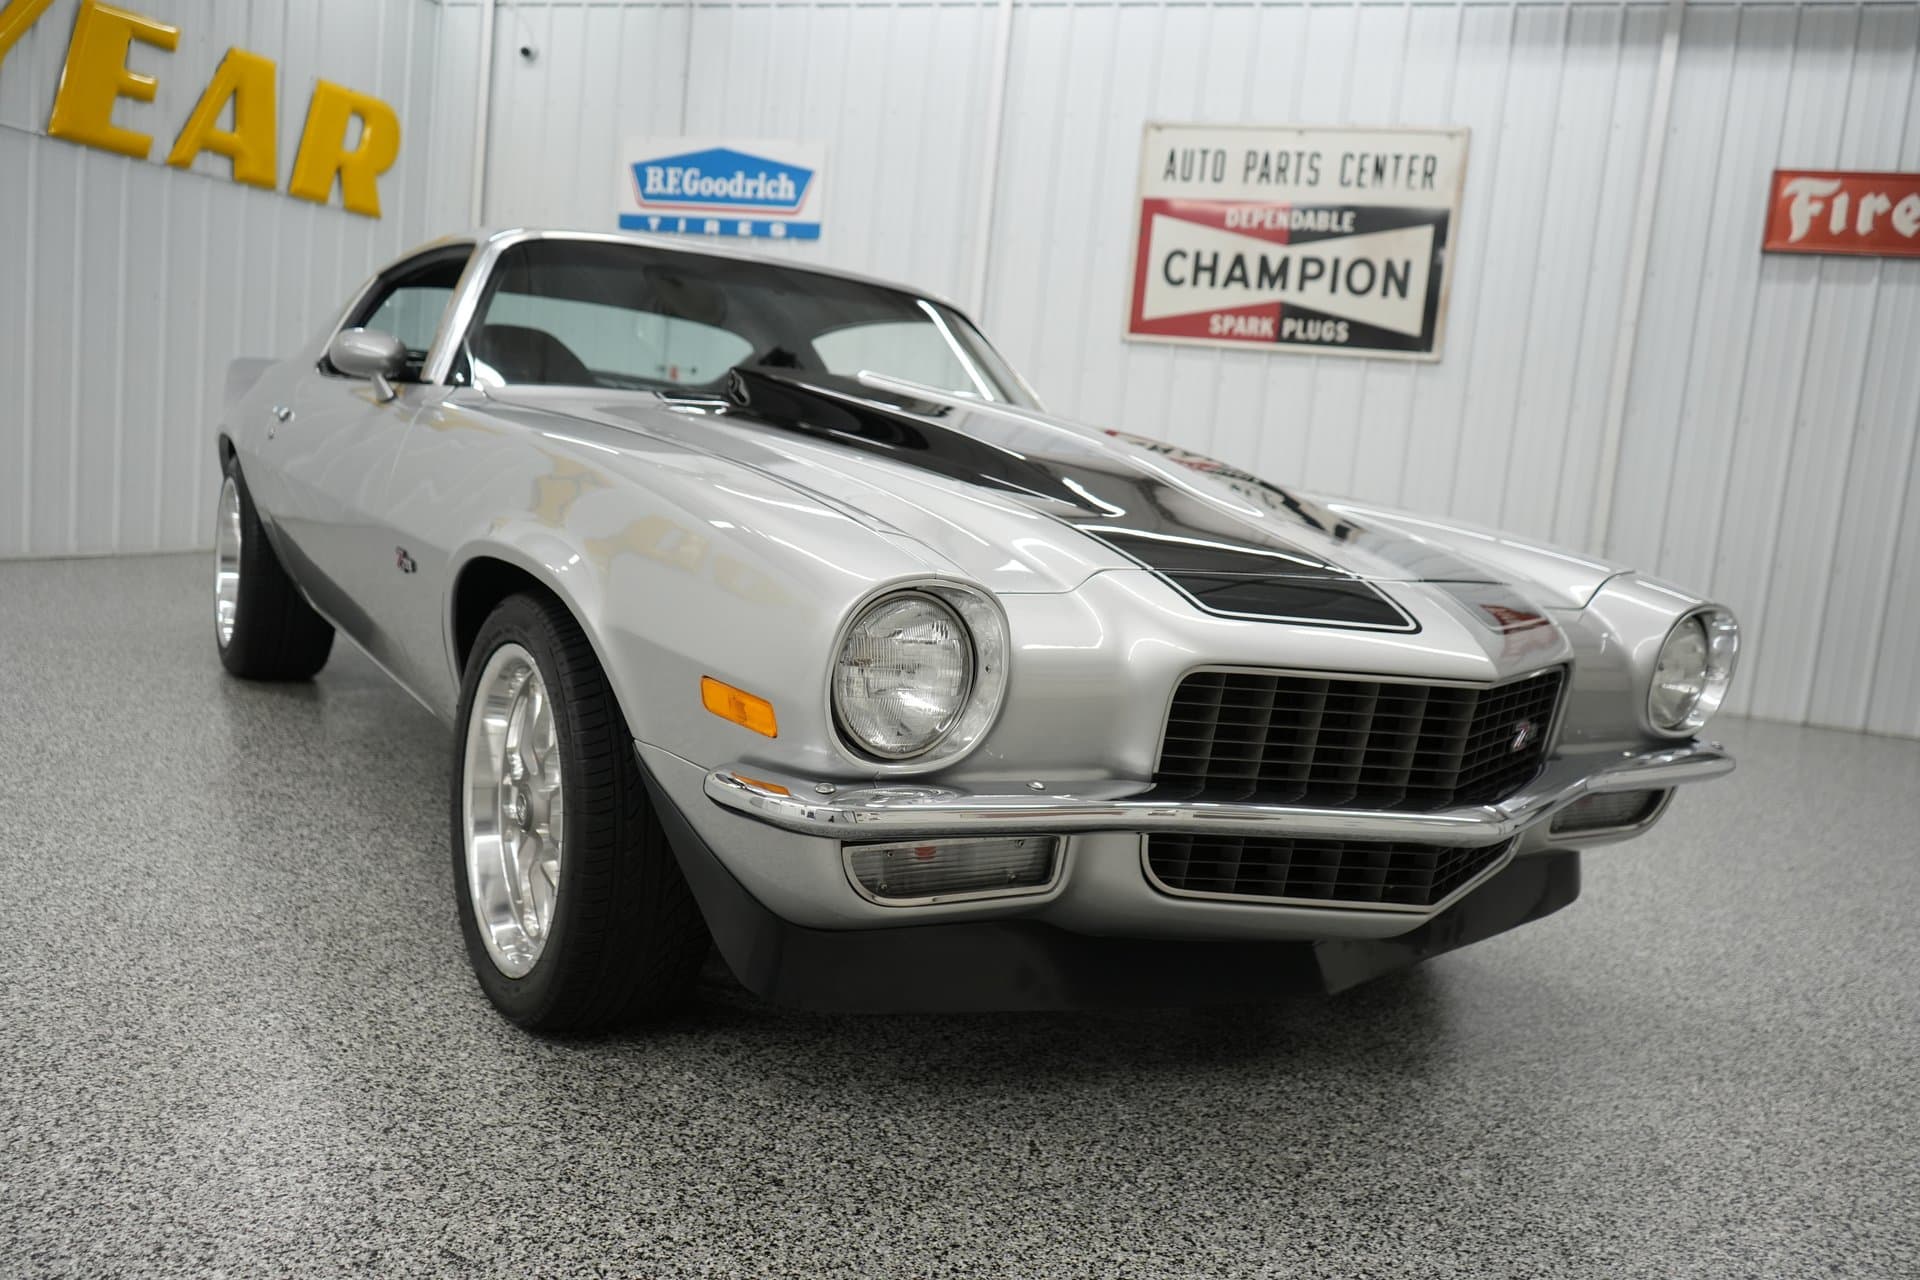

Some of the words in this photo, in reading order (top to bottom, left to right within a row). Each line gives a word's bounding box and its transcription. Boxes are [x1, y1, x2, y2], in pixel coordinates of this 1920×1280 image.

[0, 0, 400, 219] EAR
[1163, 147, 1226, 182] AUTO
[1243, 150, 1321, 186] PARTS
[1340, 153, 1437, 190] CENTER
[647, 217, 787, 237] TIRES
[1224, 207, 1356, 233] DEPENDABLE
[1163, 249, 1411, 299] CHAMPION
[1209, 314, 1274, 338] SPARK
[1281, 317, 1349, 342] PLUGS
